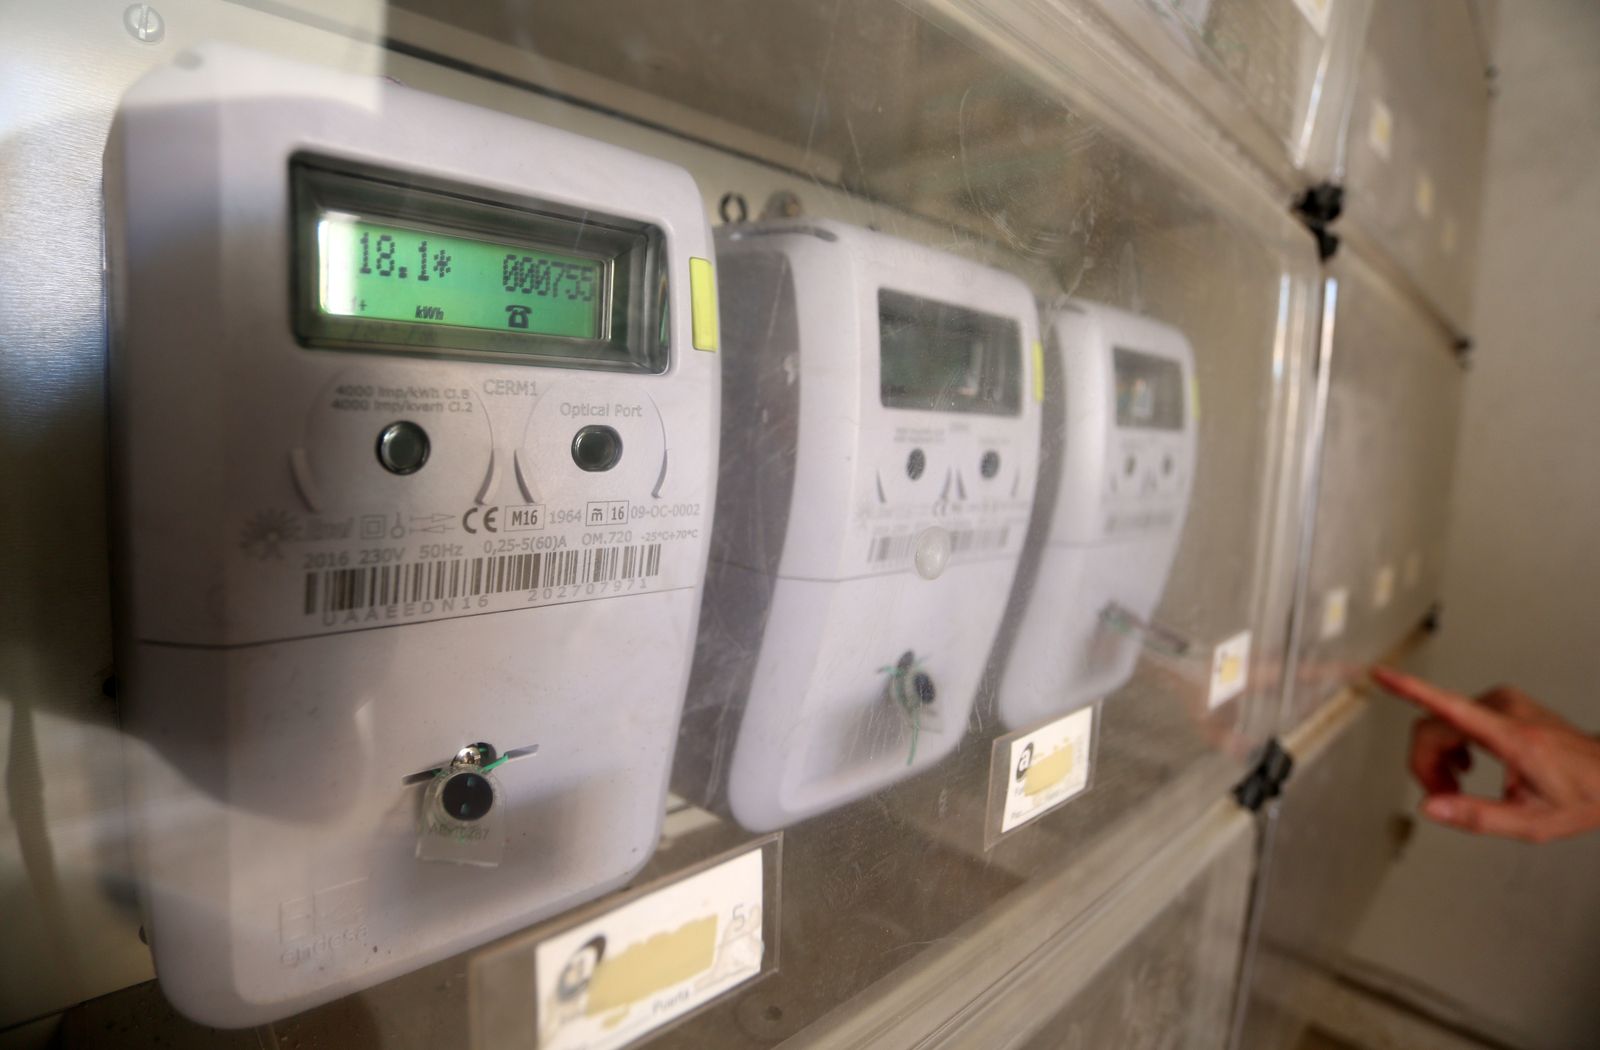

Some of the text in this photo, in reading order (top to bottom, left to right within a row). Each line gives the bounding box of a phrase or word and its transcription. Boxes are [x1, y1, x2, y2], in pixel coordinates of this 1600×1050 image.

[502, 254, 593, 302] 000755
[415, 305, 444, 321] kWh
[336, 385, 373, 397] 4000
[483, 379, 538, 396] CERM1
[331, 398, 369, 410] 4000
[560, 402, 643, 418] Optical Port
[462, 506, 499, 534] CE
[511, 509, 538, 526] M16
[550, 510, 582, 524] 1964
[611, 507, 624, 520] 16
[630, 504, 700, 519] 09-OC-0002
[303, 551, 350, 569] 2016
[359, 548, 406, 565] 230V
[419, 544, 464, 560] 50Hz
[483, 535, 567, 554] 0,25-5(60)A
[581, 531, 632, 546] OM.720
